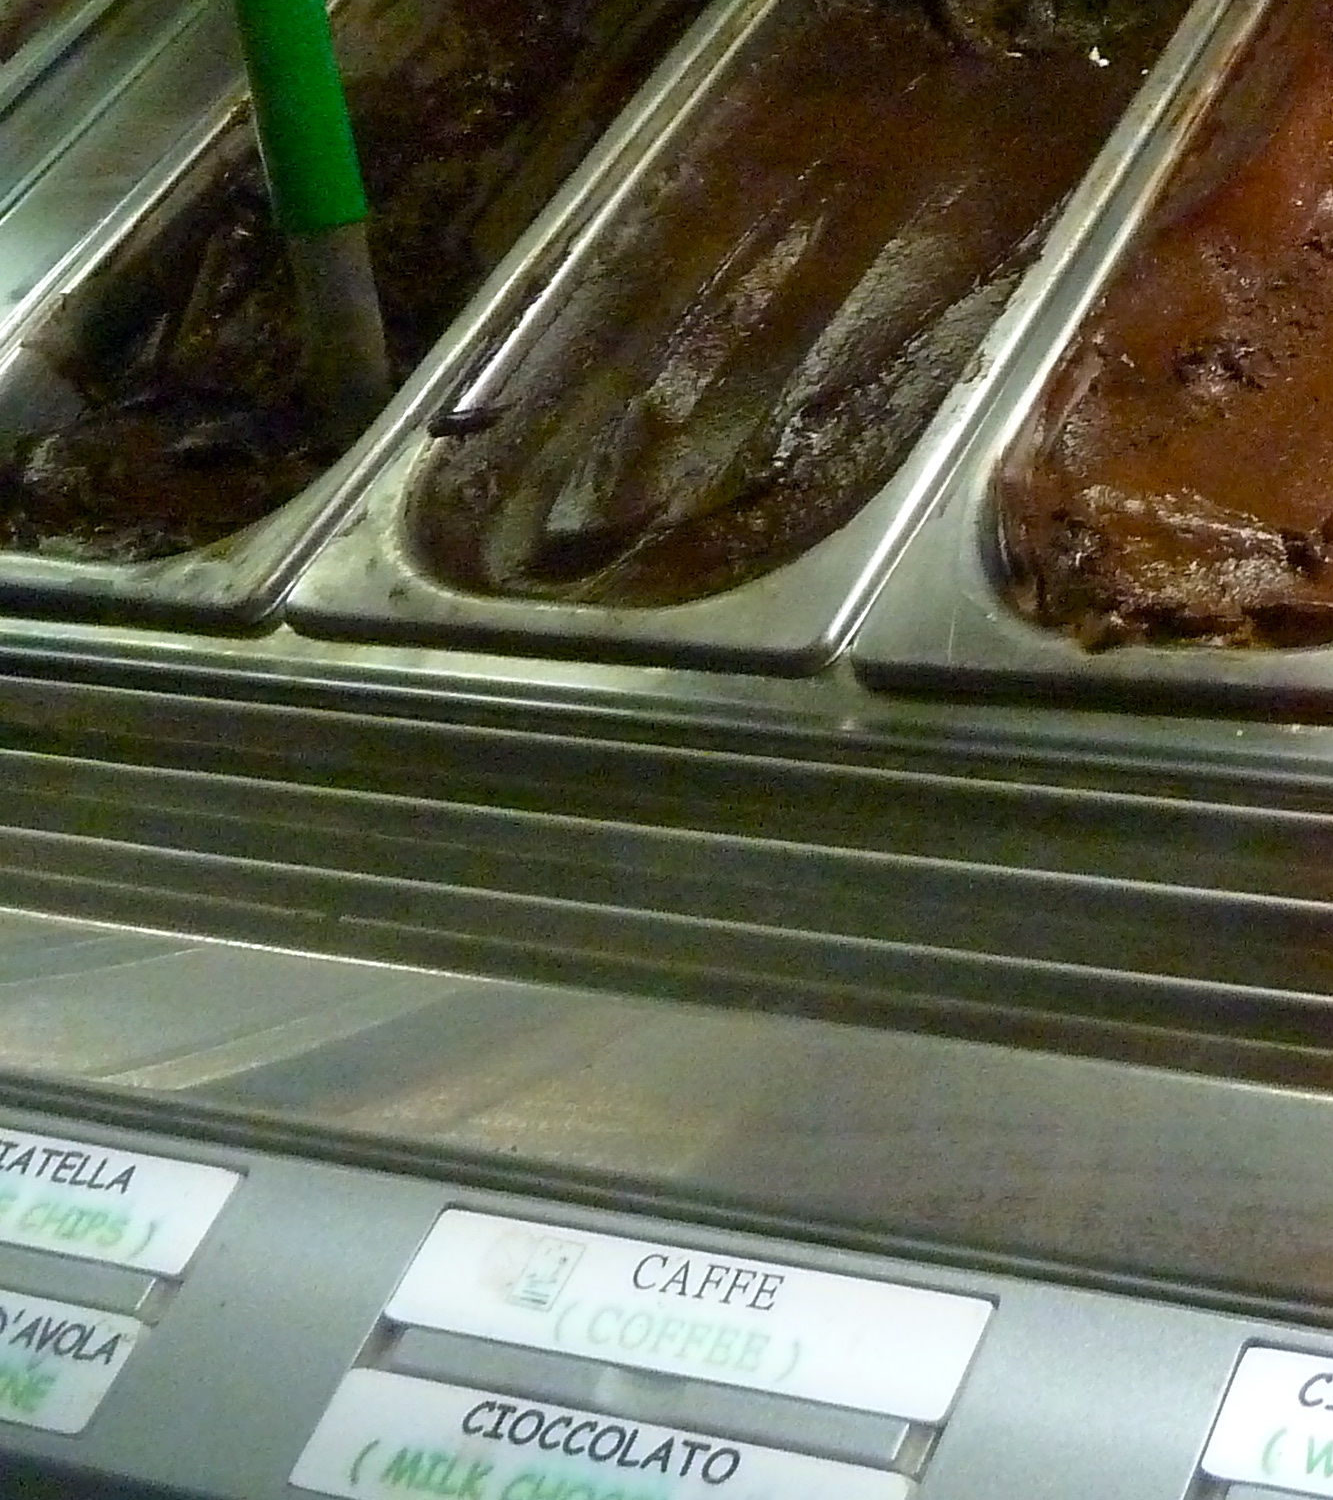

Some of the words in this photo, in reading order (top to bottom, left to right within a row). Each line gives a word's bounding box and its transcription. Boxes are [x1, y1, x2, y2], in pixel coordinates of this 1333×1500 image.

[632, 1253, 785, 1311] CAFFE
[586, 1307, 771, 1372] COFFEE
[461, 1399, 741, 1484] CIOCCOLATO
